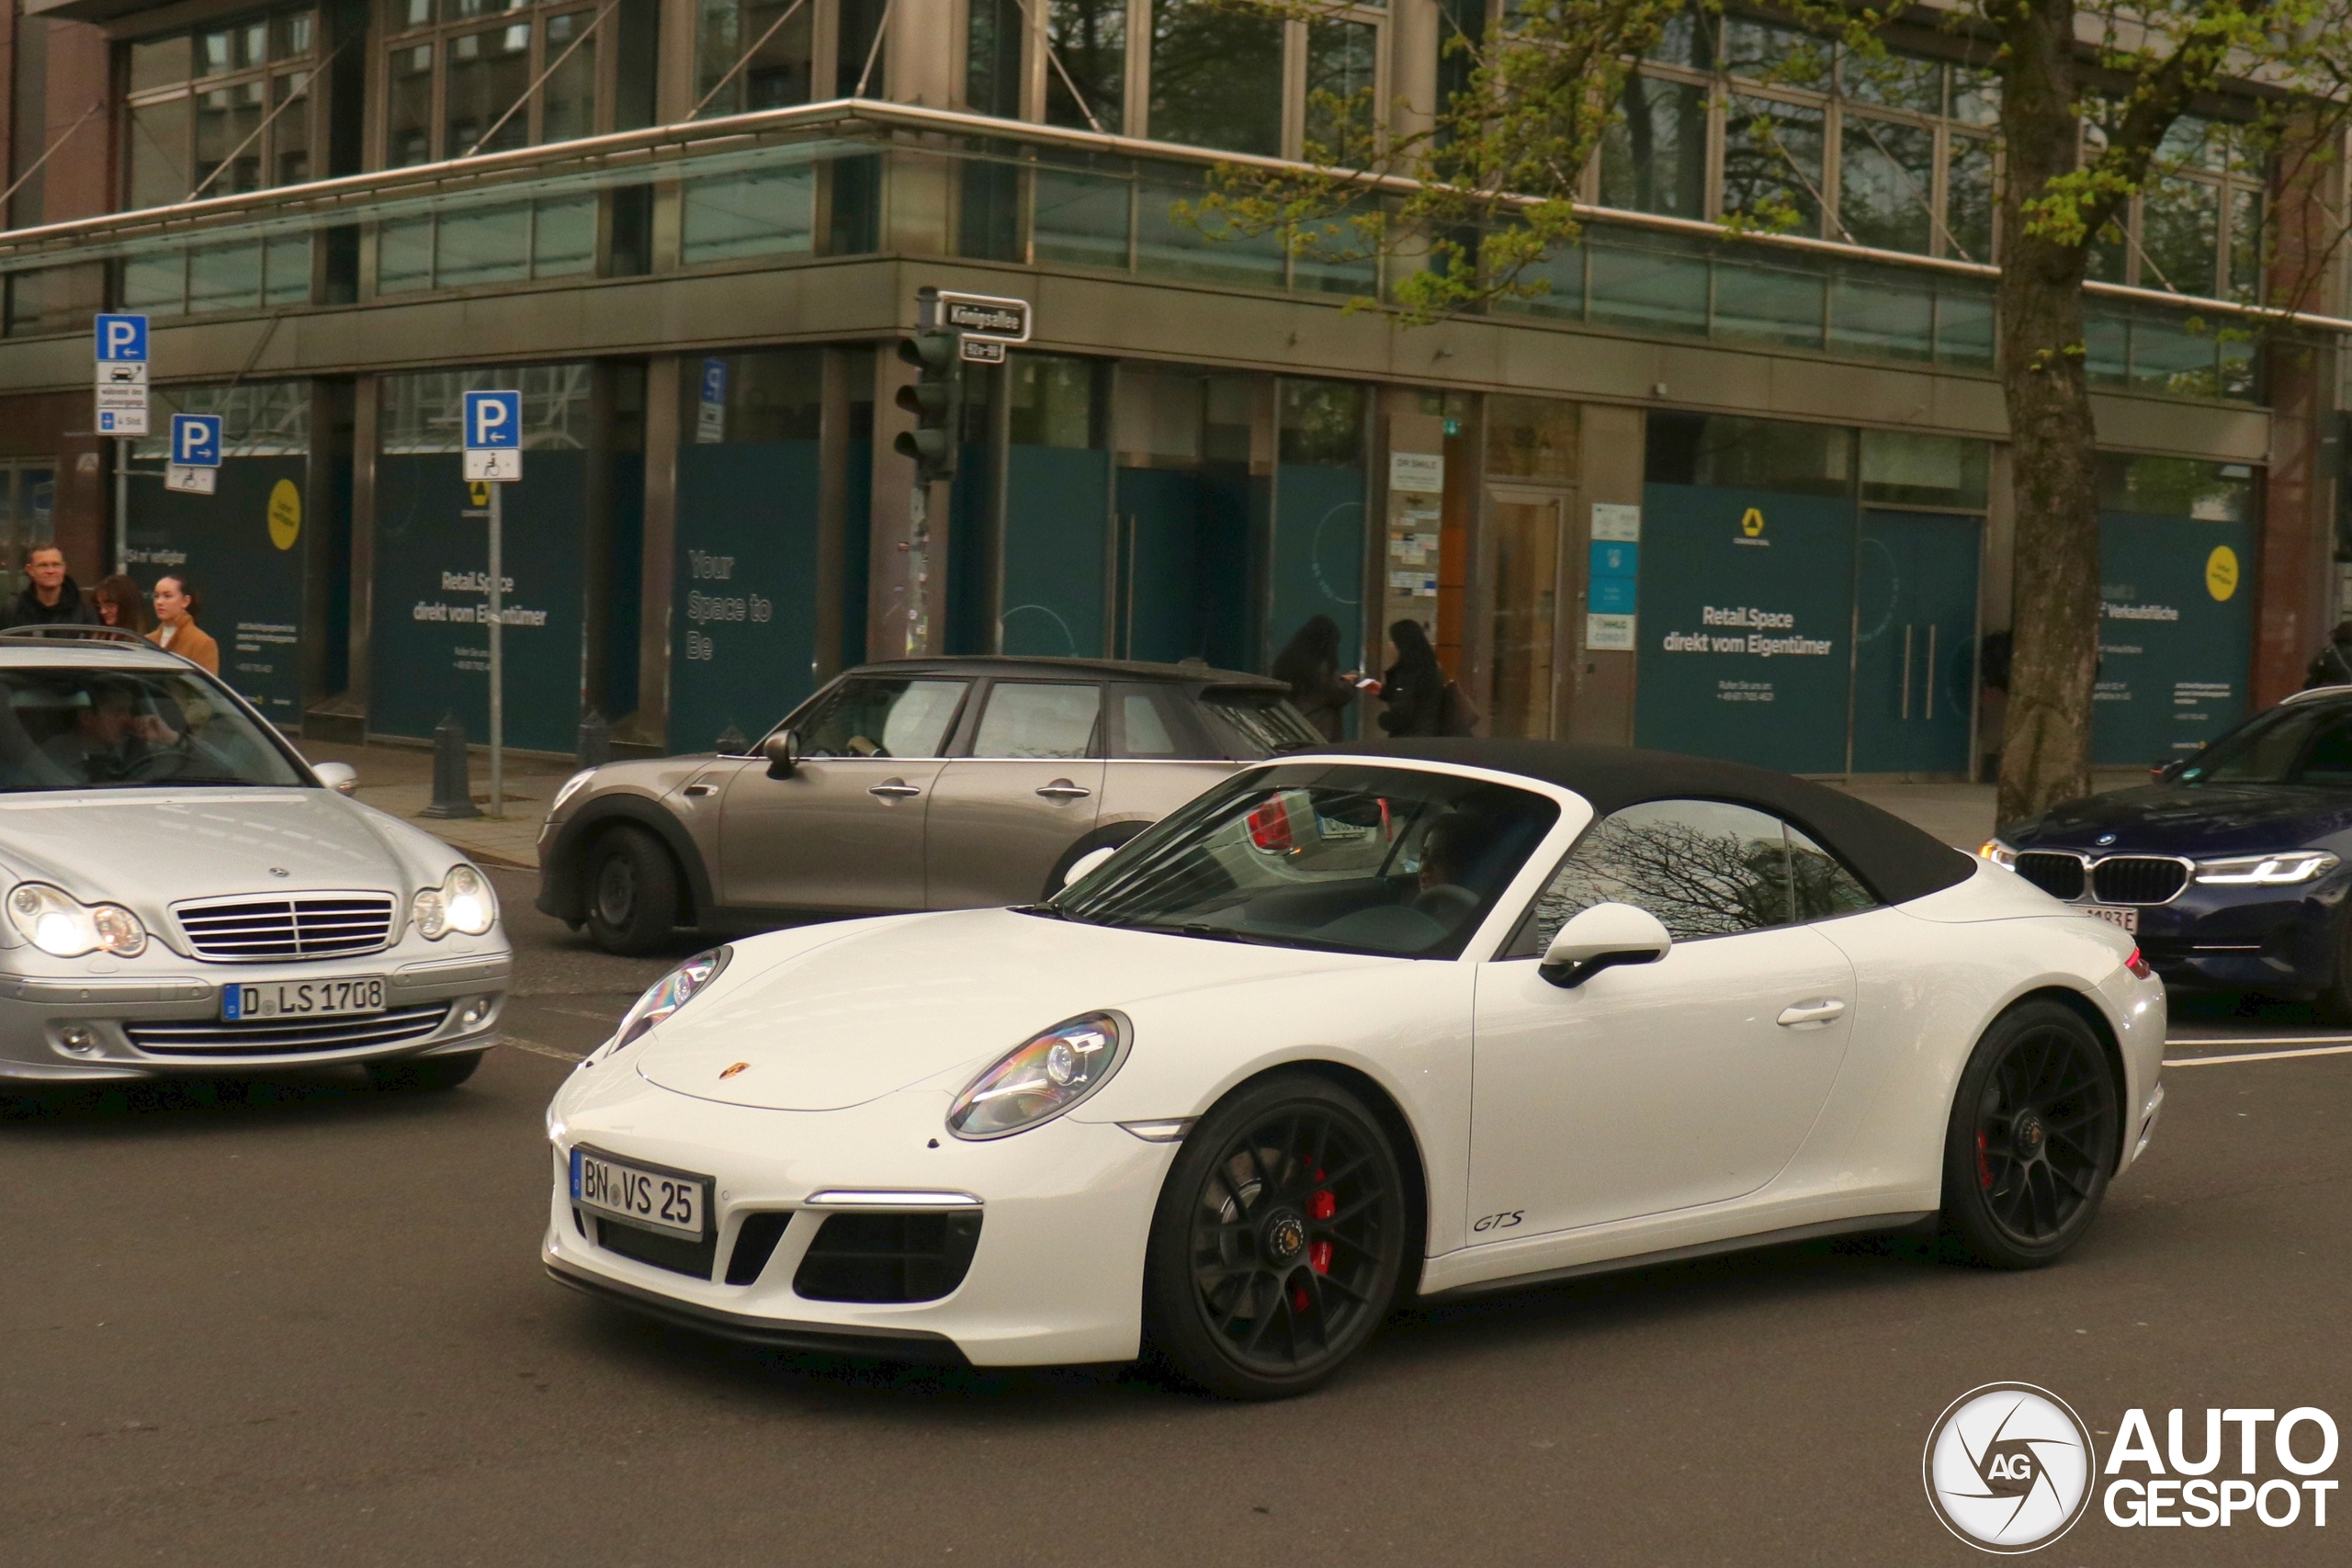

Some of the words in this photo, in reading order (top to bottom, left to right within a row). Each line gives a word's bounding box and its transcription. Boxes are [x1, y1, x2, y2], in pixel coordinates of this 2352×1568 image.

[951, 305, 1020, 330] Königsallee
[107, 321, 137, 359] P
[476, 399, 507, 444] P
[183, 421, 210, 459] P
[689, 550, 735, 580] Your
[441, 570, 514, 595] Retail.Spce
[413, 601, 447, 622] direkt
[448, 606, 475, 623] vom
[686, 590, 747, 625] Space
[749, 593, 773, 623] to
[1702, 605, 1794, 630] Retail.Space
[686, 630, 713, 660] Be
[1663, 631, 1709, 652] direkt
[1712, 636, 1745, 653] vom
[1747, 634, 1832, 657] Eigentümer
[243, 987, 258, 1015] D
[279, 985, 312, 1013] LS
[321, 980, 381, 1010] 1708
[584, 1157, 608, 1203] BN
[622, 1170, 651, 1214] VS
[661, 1181, 692, 1224] 25
[1474, 1210, 1525, 1232] GTS
